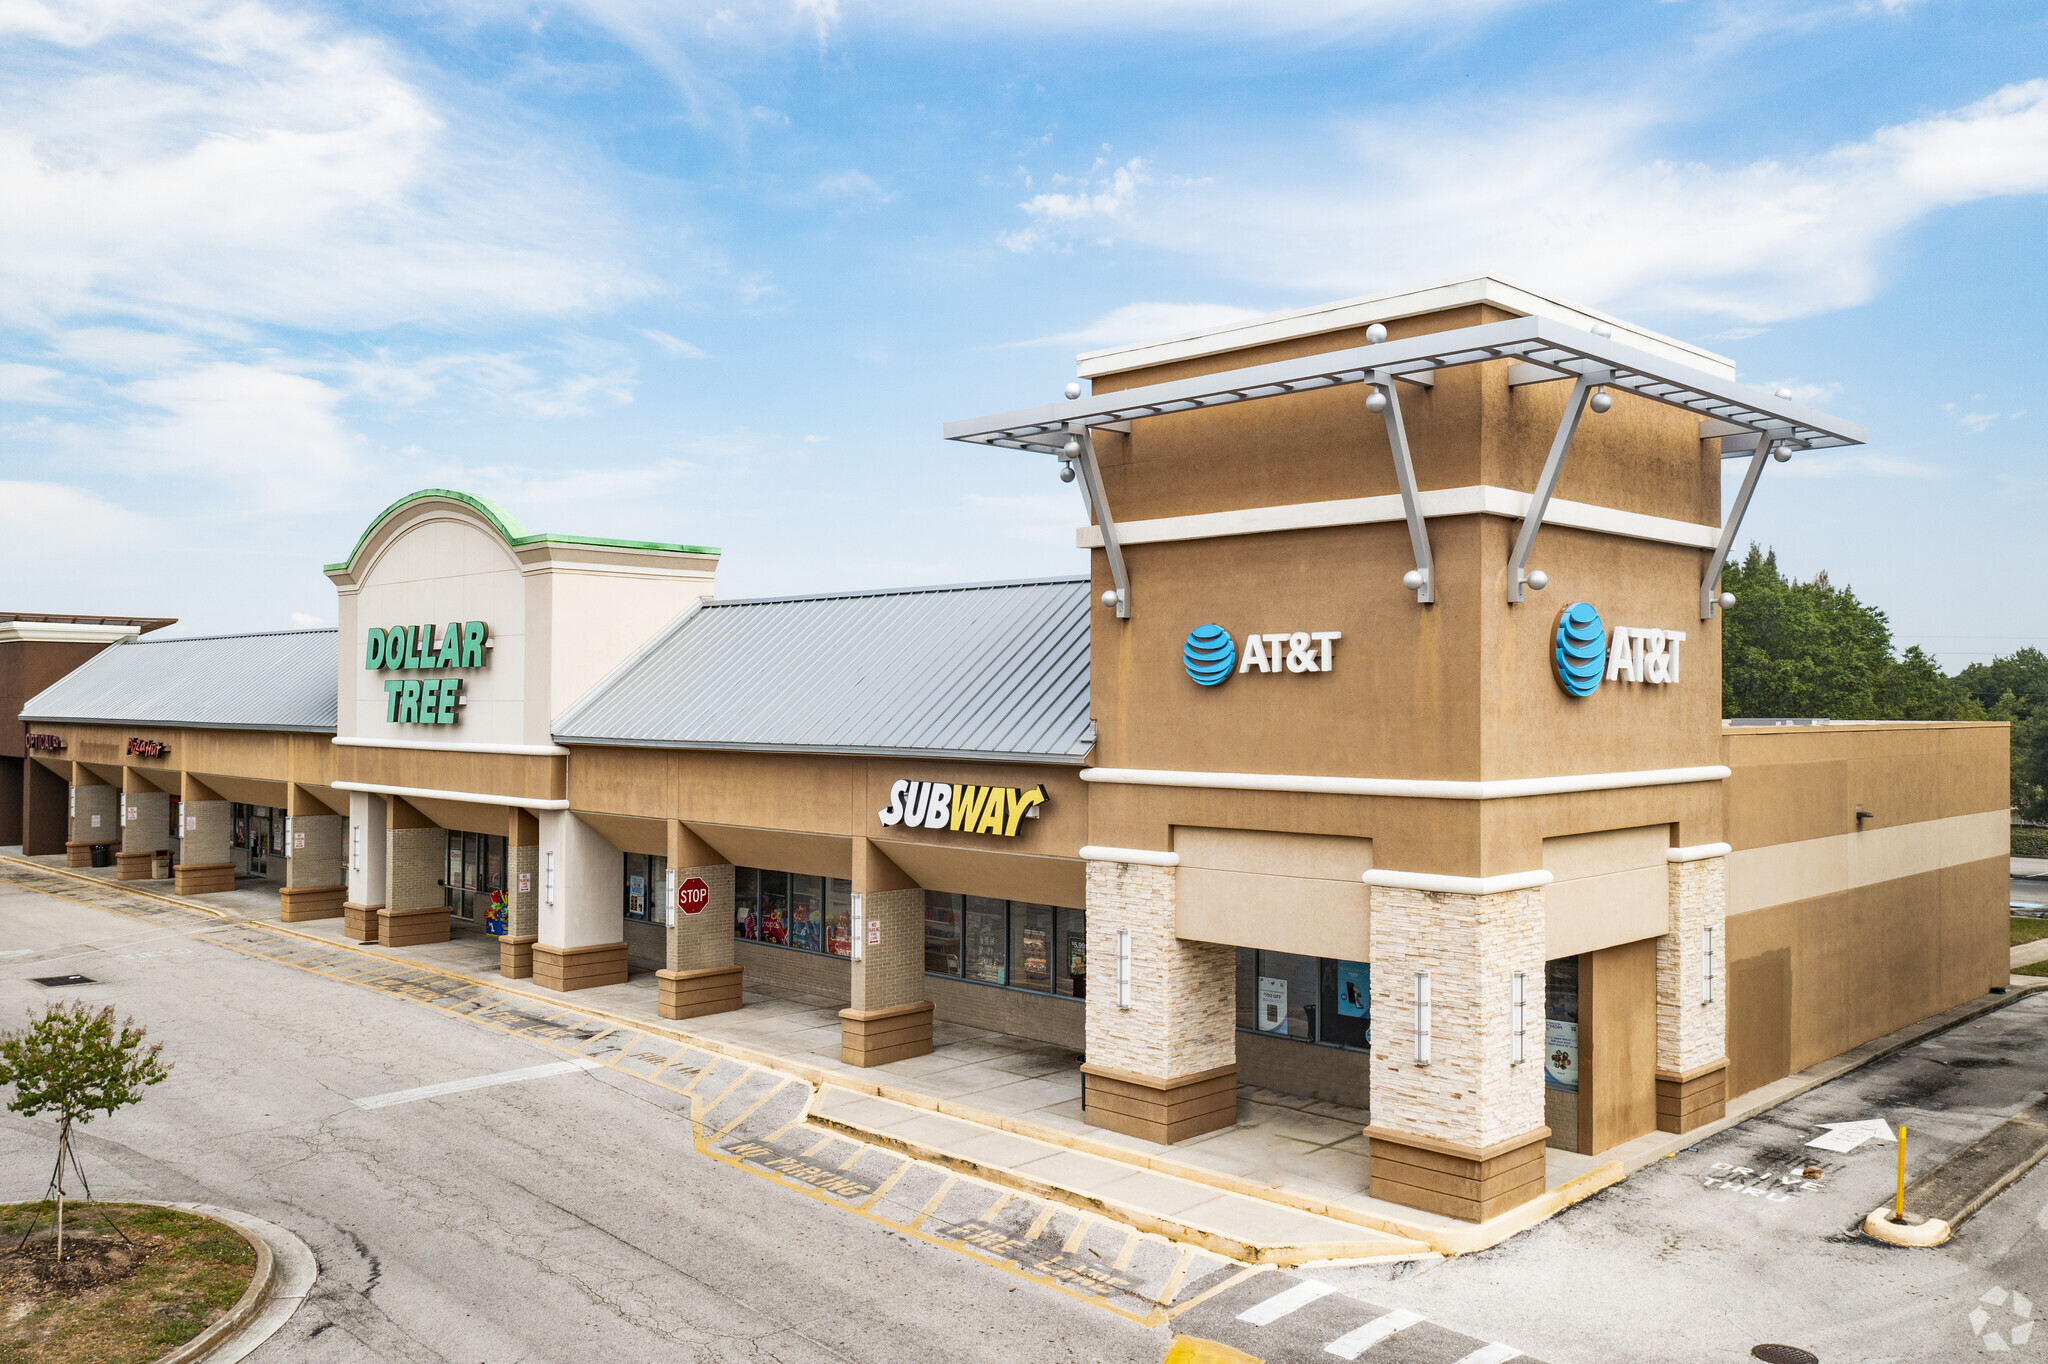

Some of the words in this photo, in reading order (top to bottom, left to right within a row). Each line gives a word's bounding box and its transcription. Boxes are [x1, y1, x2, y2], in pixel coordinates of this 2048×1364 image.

[365, 620, 489, 670] DOLLAR
[1239, 631, 1342, 674] AT&T
[1605, 626, 1686, 684] AT&T
[384, 678, 464, 724] TREE
[877, 779, 1050, 837] SUBWAY
[680, 888, 707, 904] STOP
[727, 1142, 774, 1158] NO
[764, 1156, 871, 1196] PARKING
[1703, 1176, 1791, 1202] THRU
[1710, 1161, 1826, 1193] DRIVE
[947, 1223, 1028, 1254] FIRE
[1034, 1255, 1132, 1294] LANE
